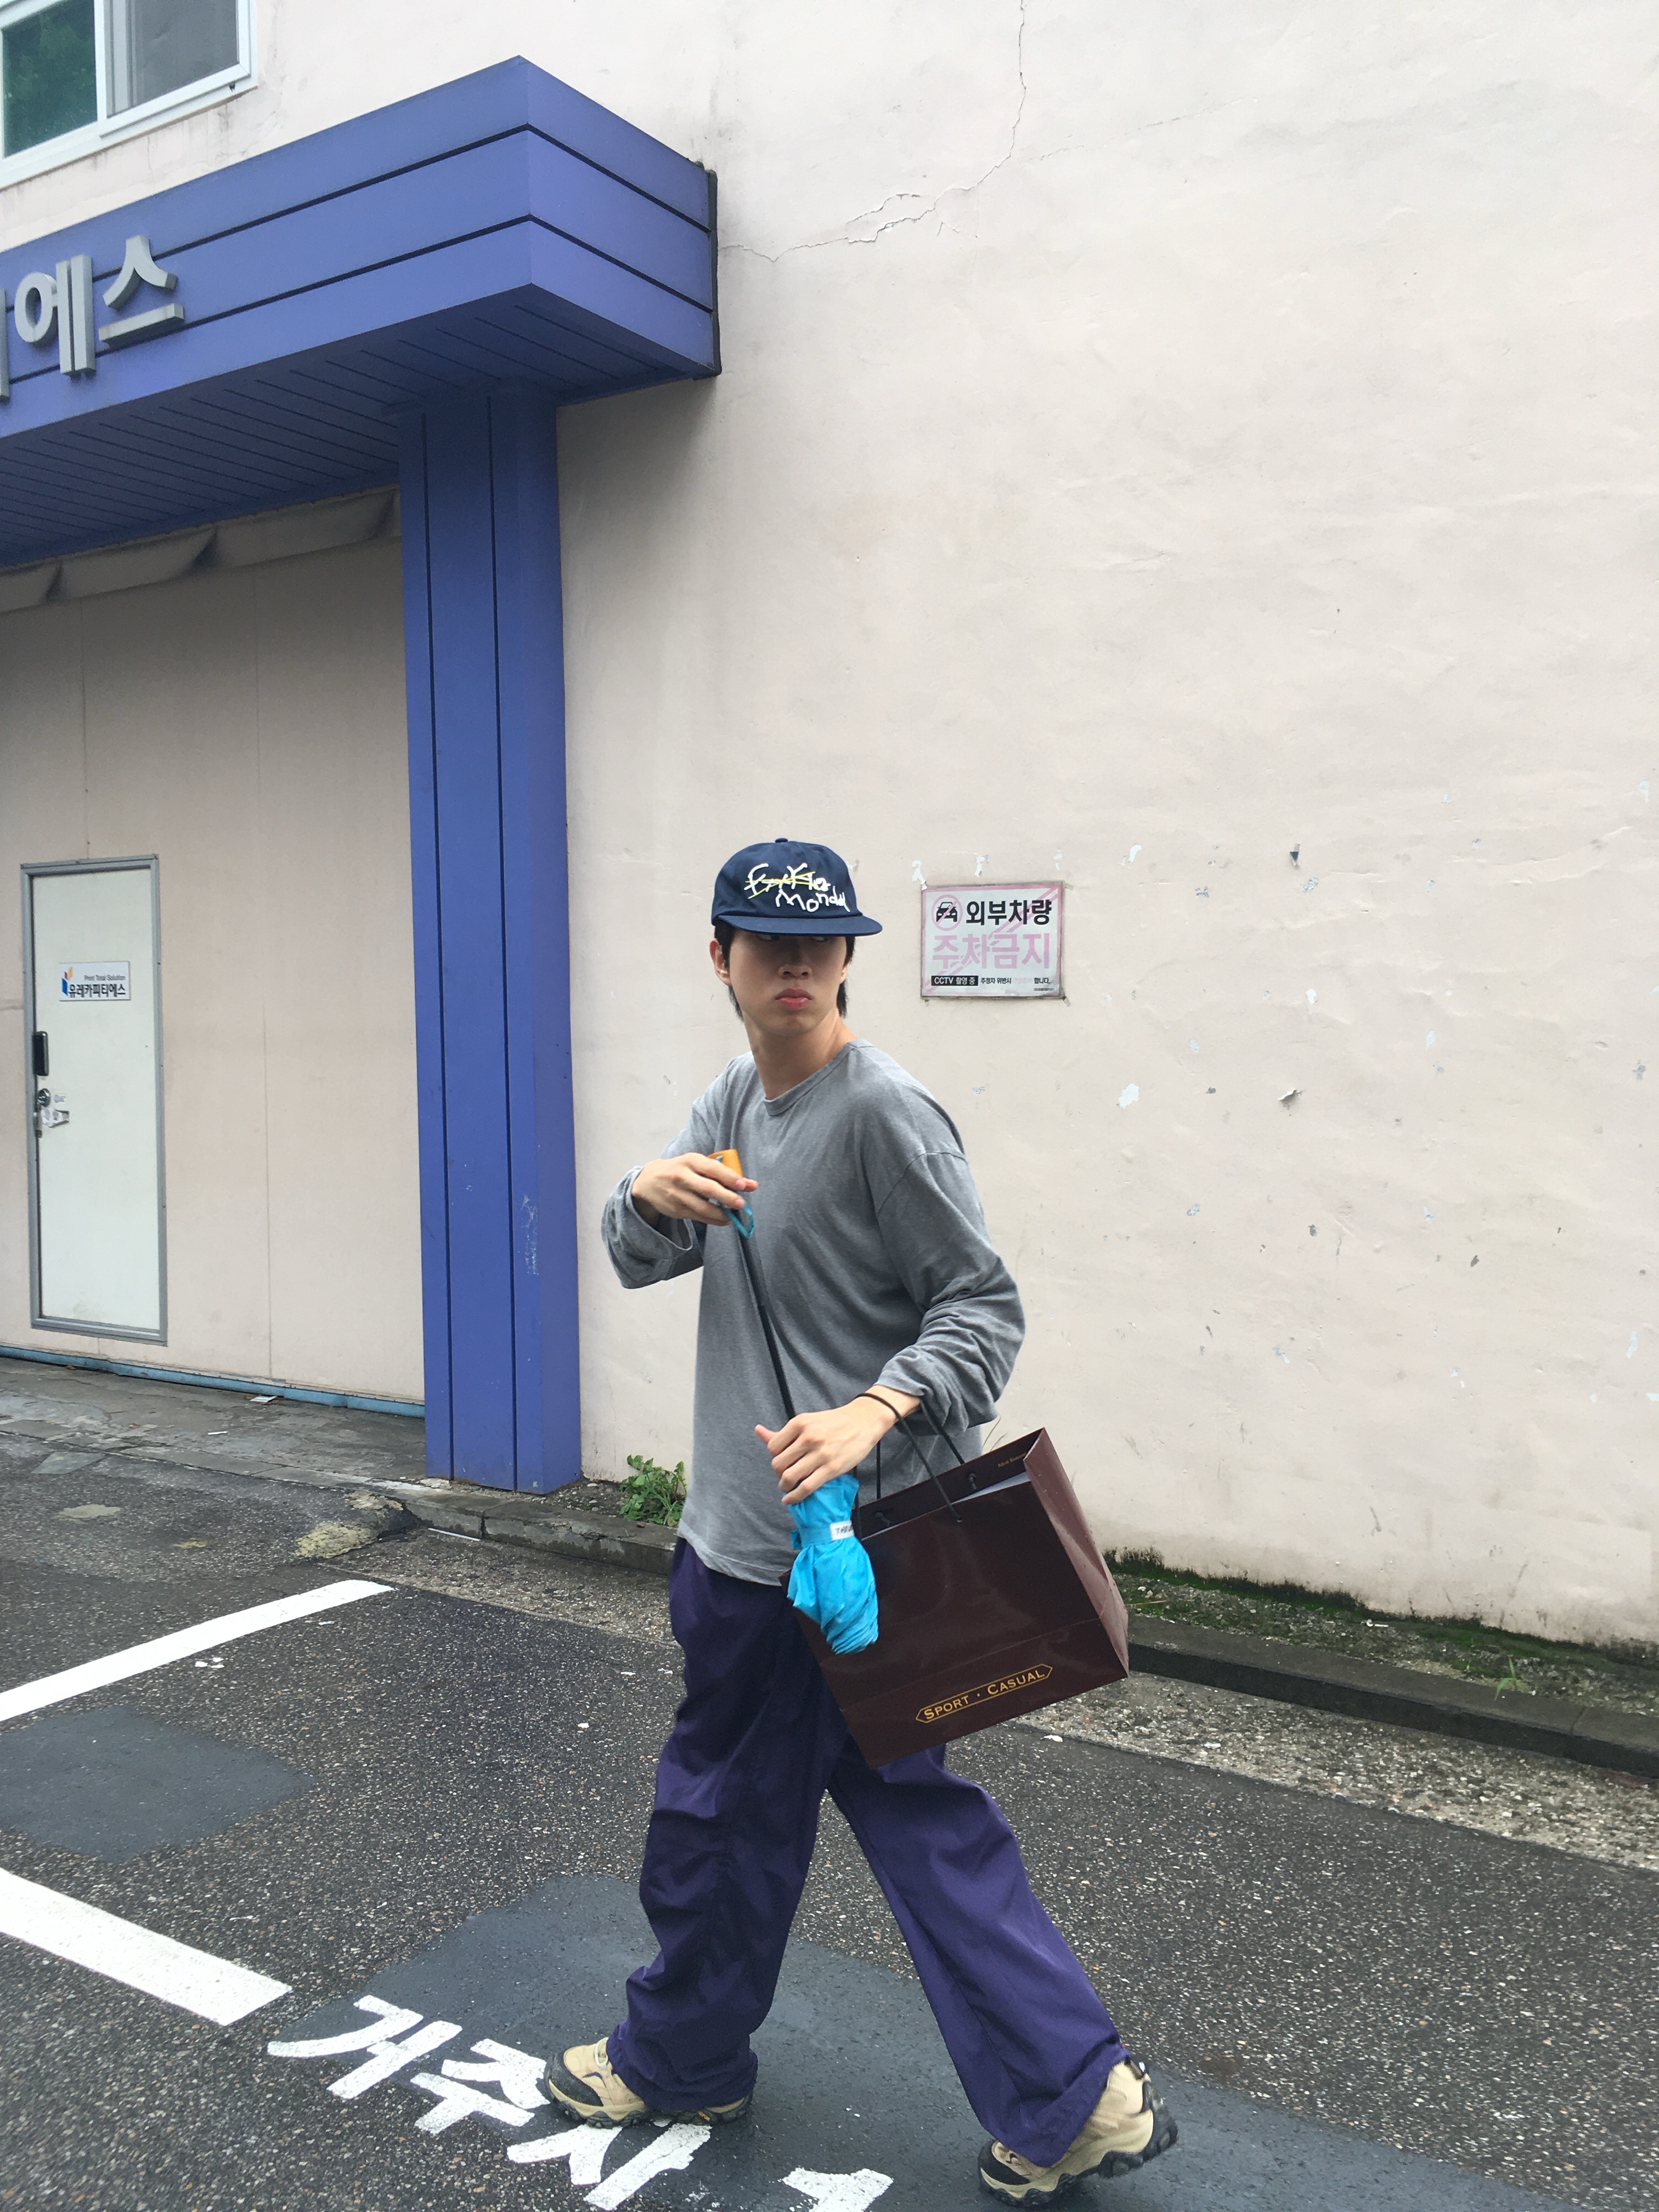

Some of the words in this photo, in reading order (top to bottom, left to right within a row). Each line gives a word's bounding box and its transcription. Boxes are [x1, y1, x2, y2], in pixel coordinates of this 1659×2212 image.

[0, 235, 184, 403] 에스
[966, 899, 1052, 926] 외부차량
[932, 933, 1050, 969] 주차금지
[69, 984, 126, 998] 유레카피티에스
[956, 977, 968, 985] 촬영
[924, 1695, 969, 1720] SPORT
[987, 1669, 1045, 1695] CASUAL
